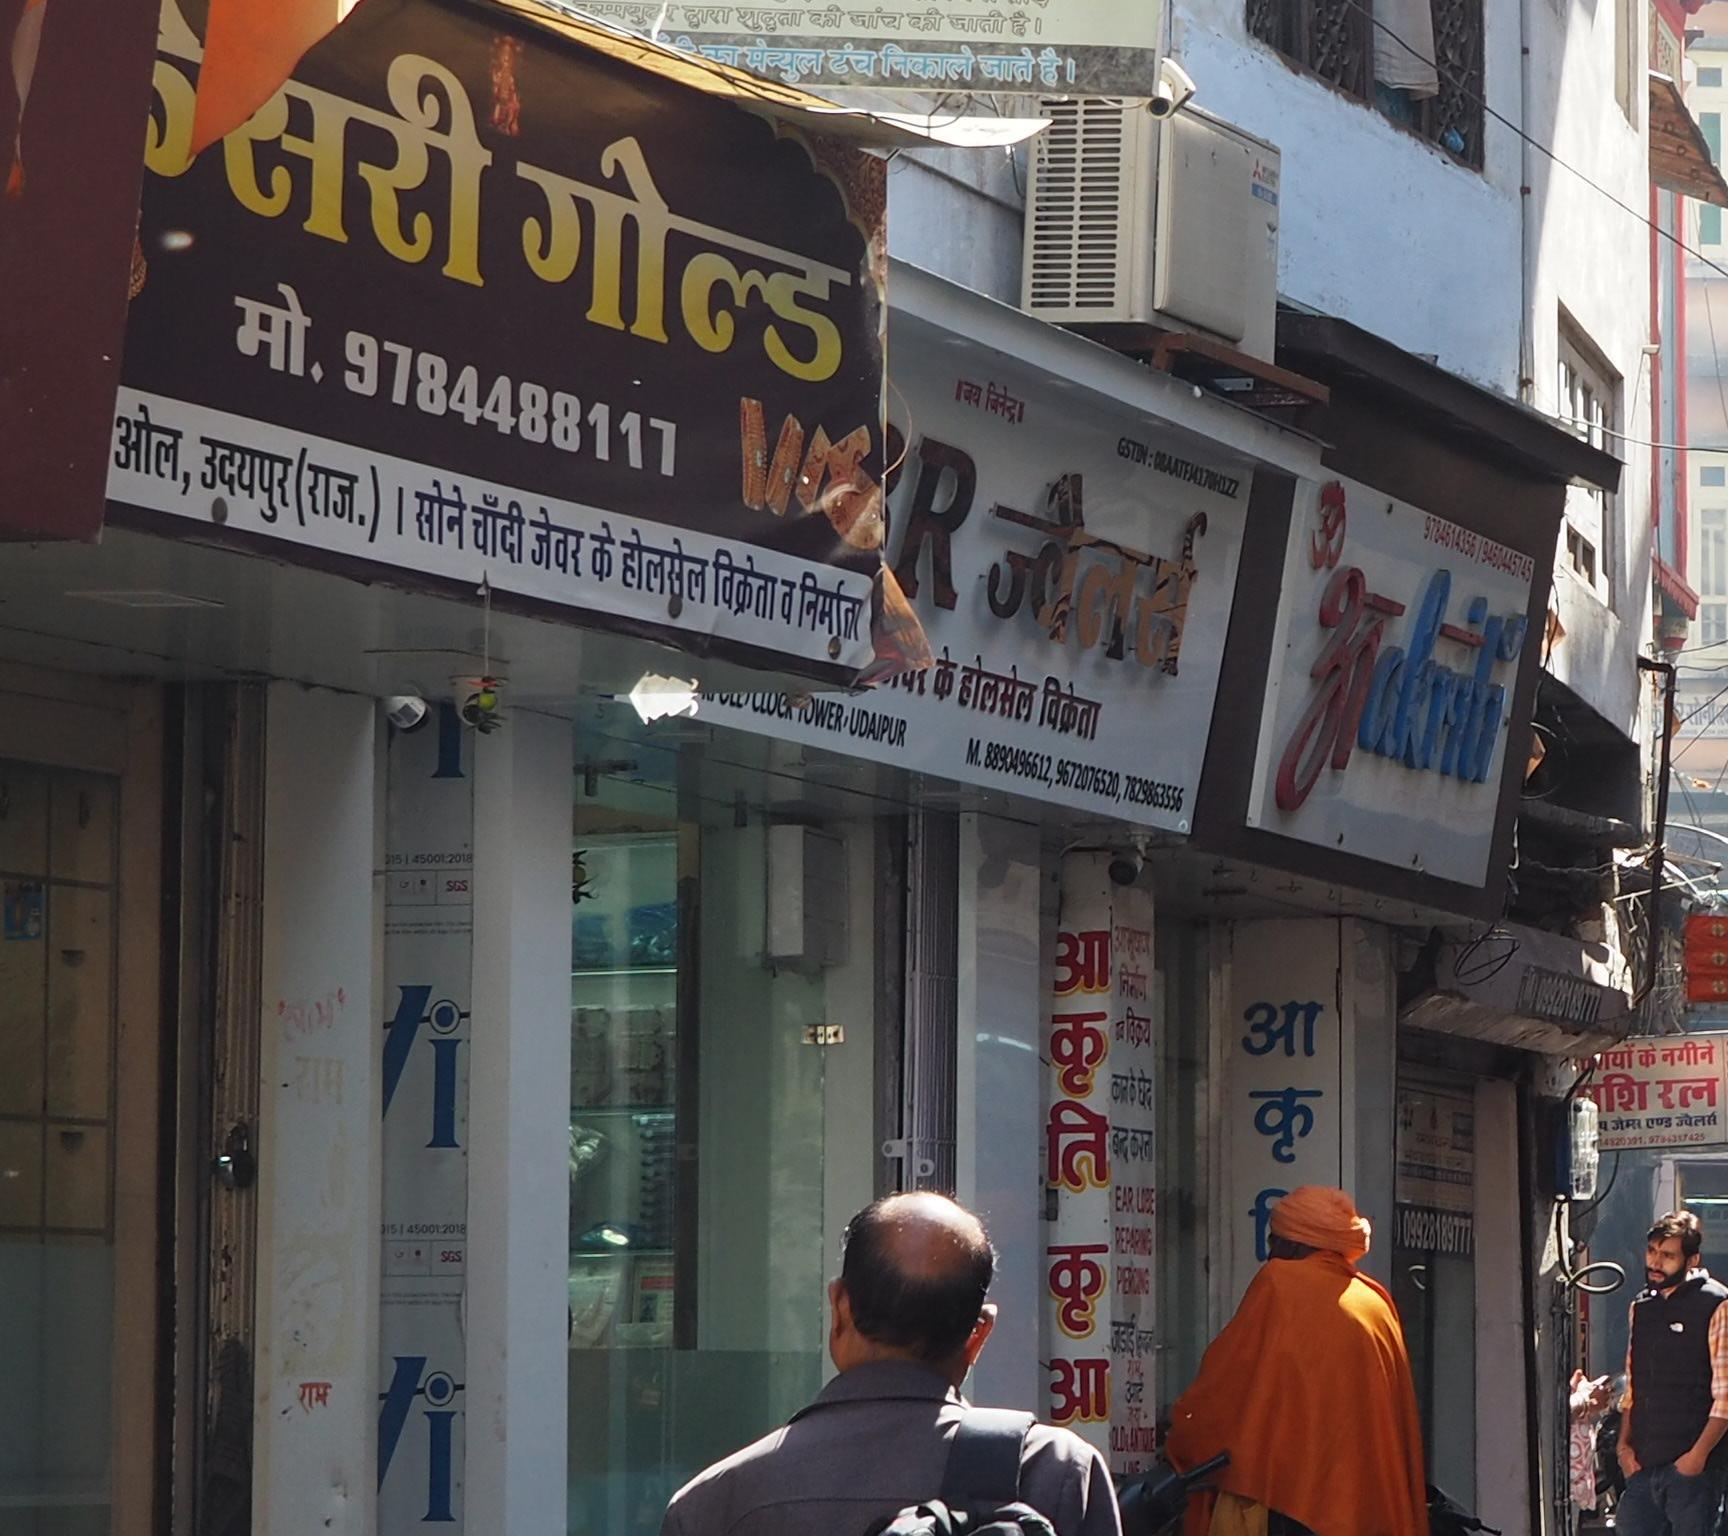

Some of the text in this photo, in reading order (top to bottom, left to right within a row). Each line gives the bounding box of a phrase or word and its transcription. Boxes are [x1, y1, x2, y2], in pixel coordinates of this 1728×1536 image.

[809, 6, 846, 29] की
[903, 8, 943, 32] की
[516, 137, 851, 382] गोल्ड
[235, 282, 676, 477] मो. 9784488117
[415, 480, 466, 550] सोने
[472, 493, 524, 564] चाँदी
[530, 507, 584, 577] जेवर
[590, 521, 615, 583] के
[621, 528, 708, 604] होलसेल
[714, 548, 778, 620] विक्रेता
[780, 578, 796, 626] व
[799, 570, 864, 642] निर्माता
[934, 646, 1102, 741] के होलसेल विक्रेता
[849, 707, 908, 748] UDAIPUR
[966, 737, 982, 766] M.
[413, 852, 472, 864] 45001:2018
[446, 879, 468, 892] SGS
[1638, 1042, 1656, 1068] के
[1661, 1040, 1714, 1066] नगीने
[1656, 1077, 1719, 1110] रत्न
[408, 1223, 466, 1234] 45001:2018
[440, 1250, 462, 1262] SGS
[298, 1381, 333, 1415] राम
